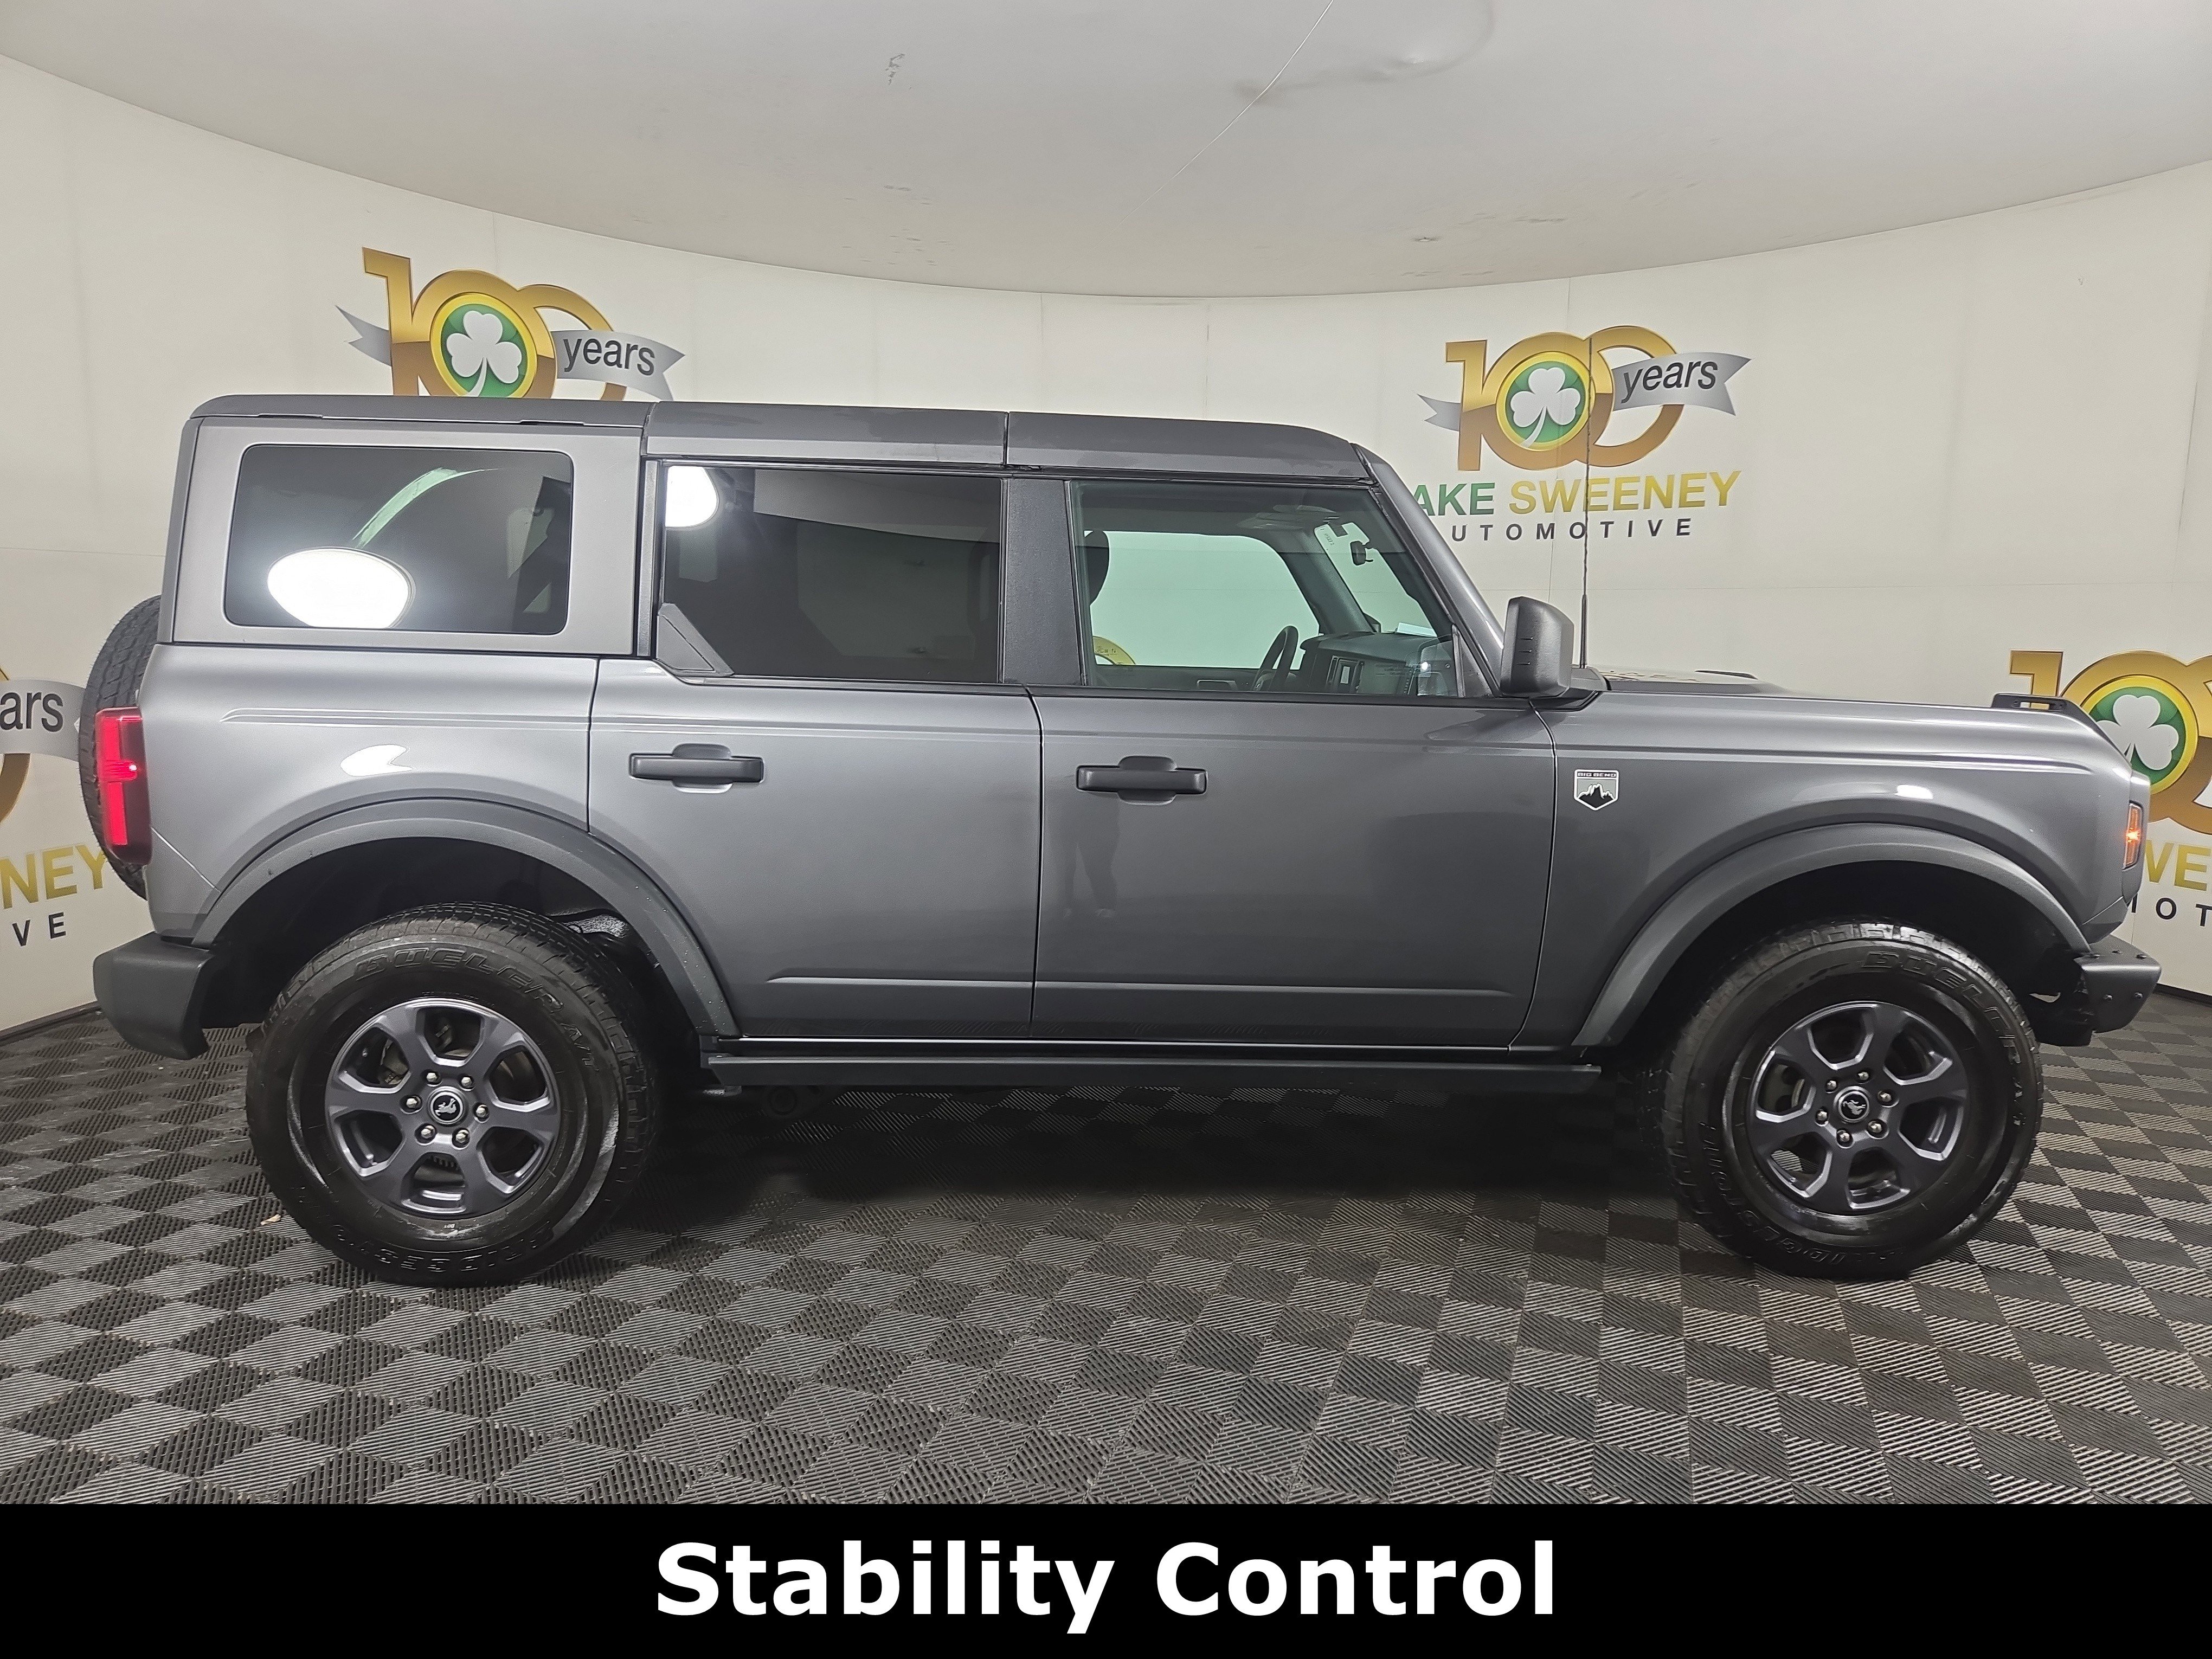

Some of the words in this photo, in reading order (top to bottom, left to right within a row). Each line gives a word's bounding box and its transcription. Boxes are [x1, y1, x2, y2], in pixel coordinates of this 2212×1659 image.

[563, 336, 656, 376] years
[1445, 325, 1685, 472] 100
[1620, 359, 1719, 404] years
[1411, 481, 1496, 517] AKE
[1508, 470, 1742, 516] SWEENEY
[1451, 517, 1692, 542] UTOMOTIVE
[0, 691, 64, 733] ars
